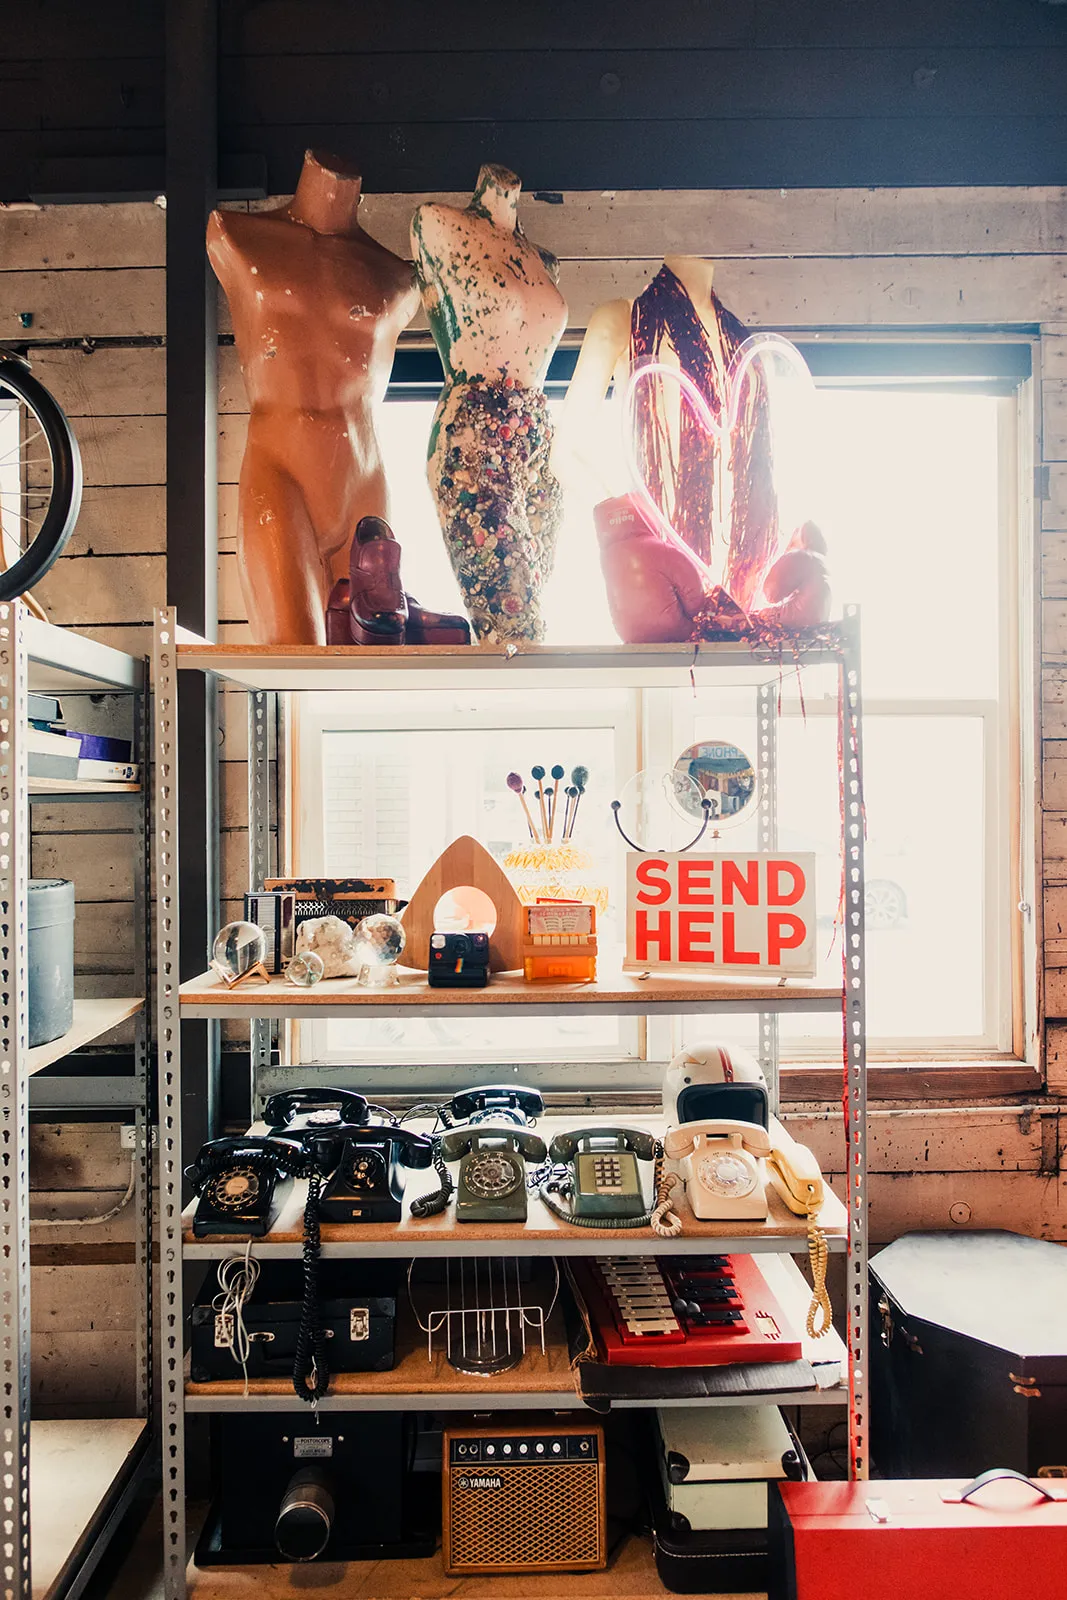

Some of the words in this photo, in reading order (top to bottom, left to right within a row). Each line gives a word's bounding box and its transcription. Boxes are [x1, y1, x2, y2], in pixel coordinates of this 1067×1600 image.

[636, 859, 806, 906] SEND
[636, 910, 807, 965] HELP
[469, 1478, 501, 1488] YAMAHA
